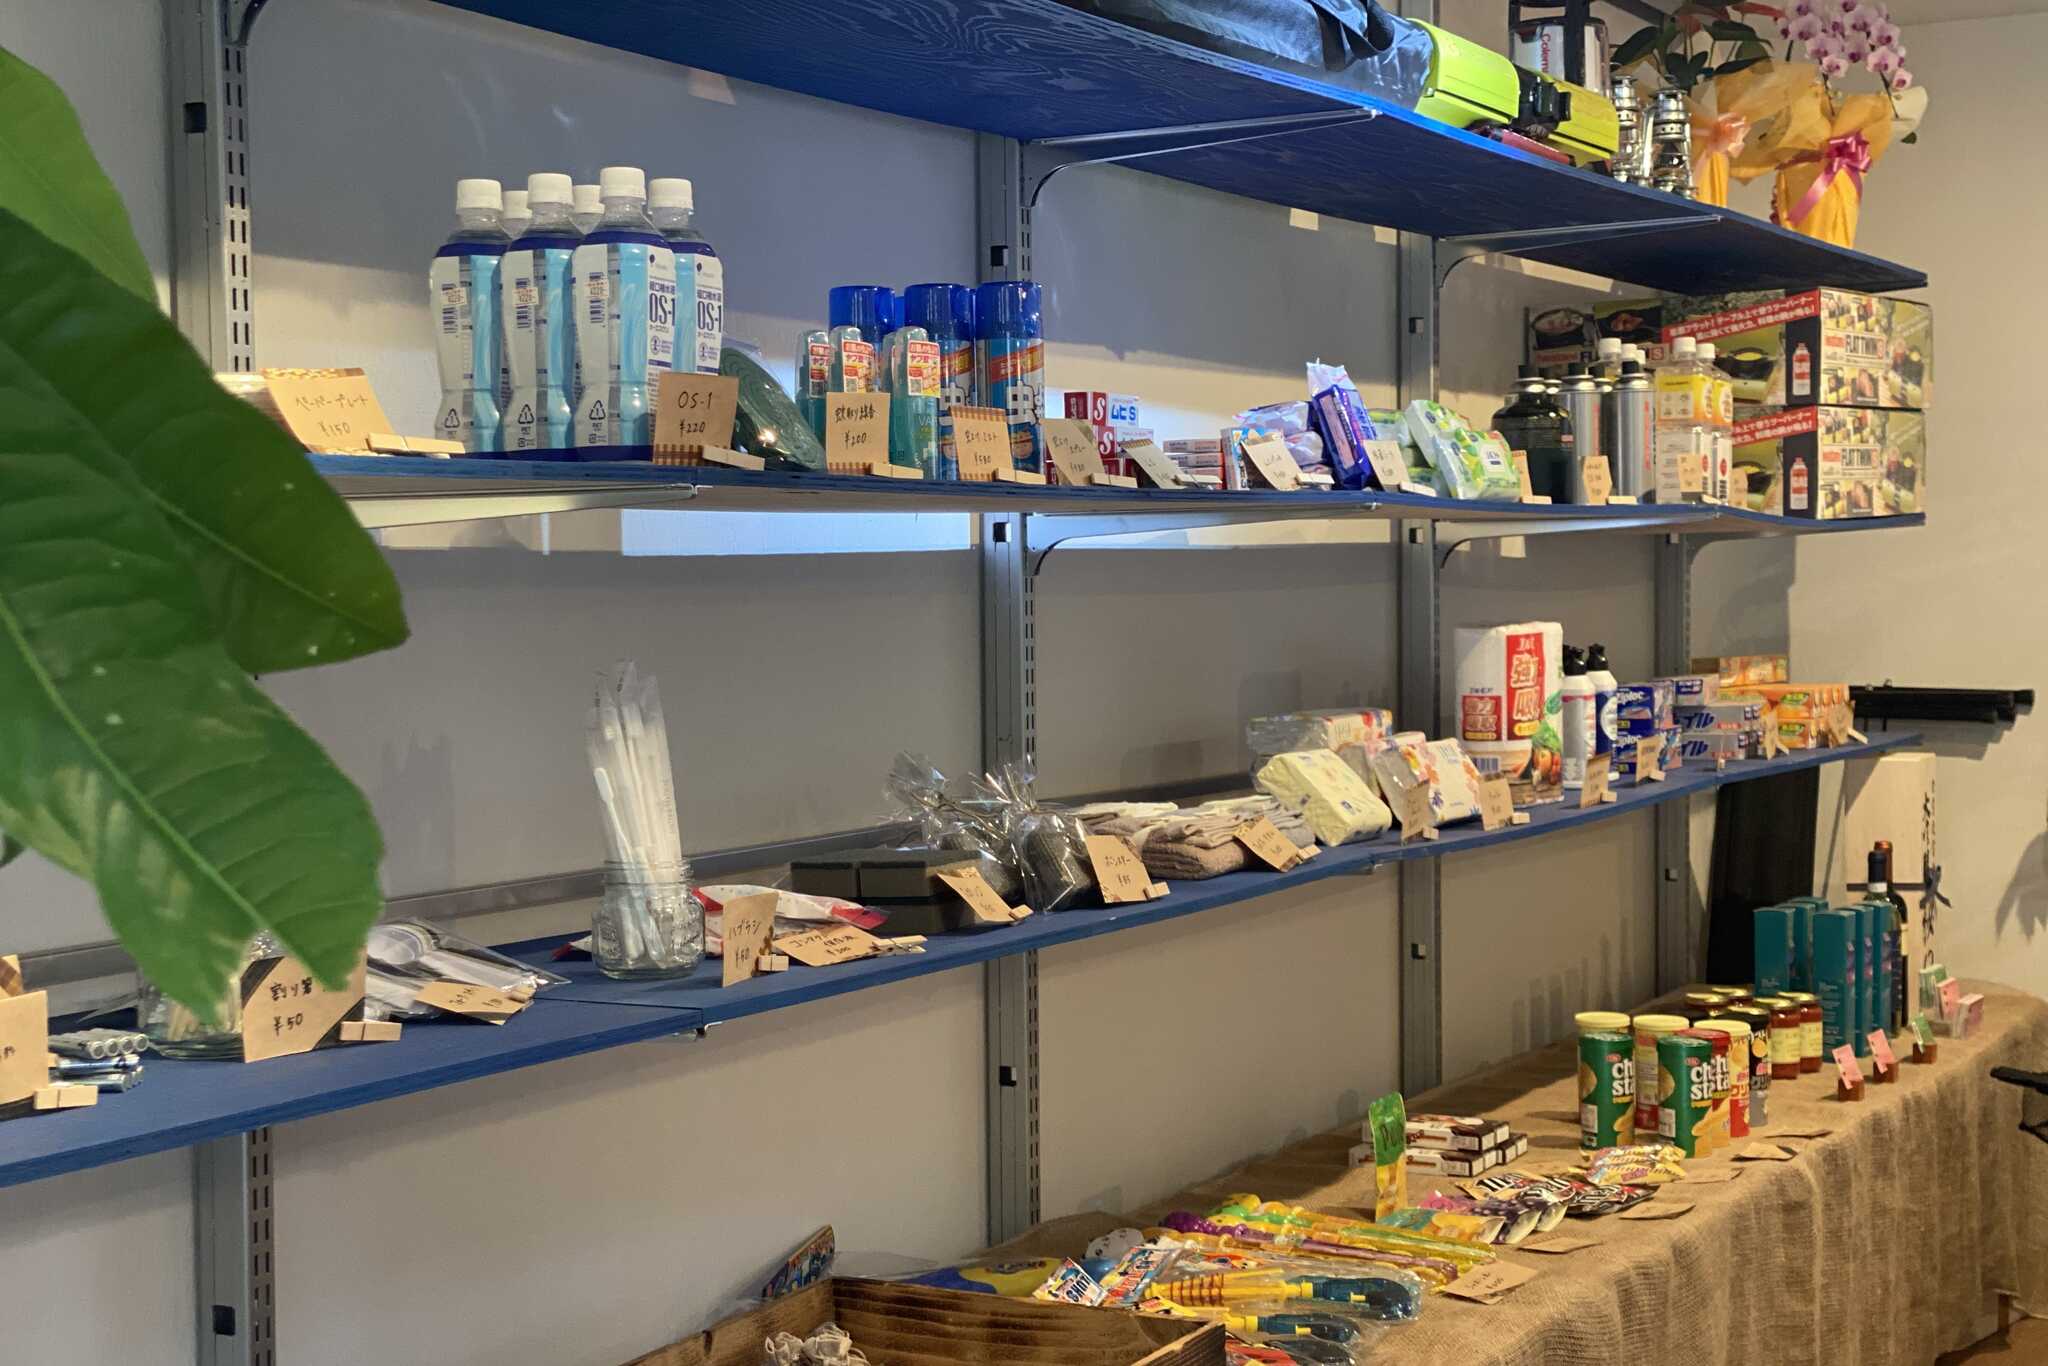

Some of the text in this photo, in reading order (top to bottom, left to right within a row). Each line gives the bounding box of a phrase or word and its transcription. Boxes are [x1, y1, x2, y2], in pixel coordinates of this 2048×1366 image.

[649, 292, 676, 327] OS-1
[697, 300, 722, 334] OS-1
[678, 391, 713, 410] OS-1
[680, 419, 706, 438] ¥220
[273, 1013, 303, 1036] ¥50
